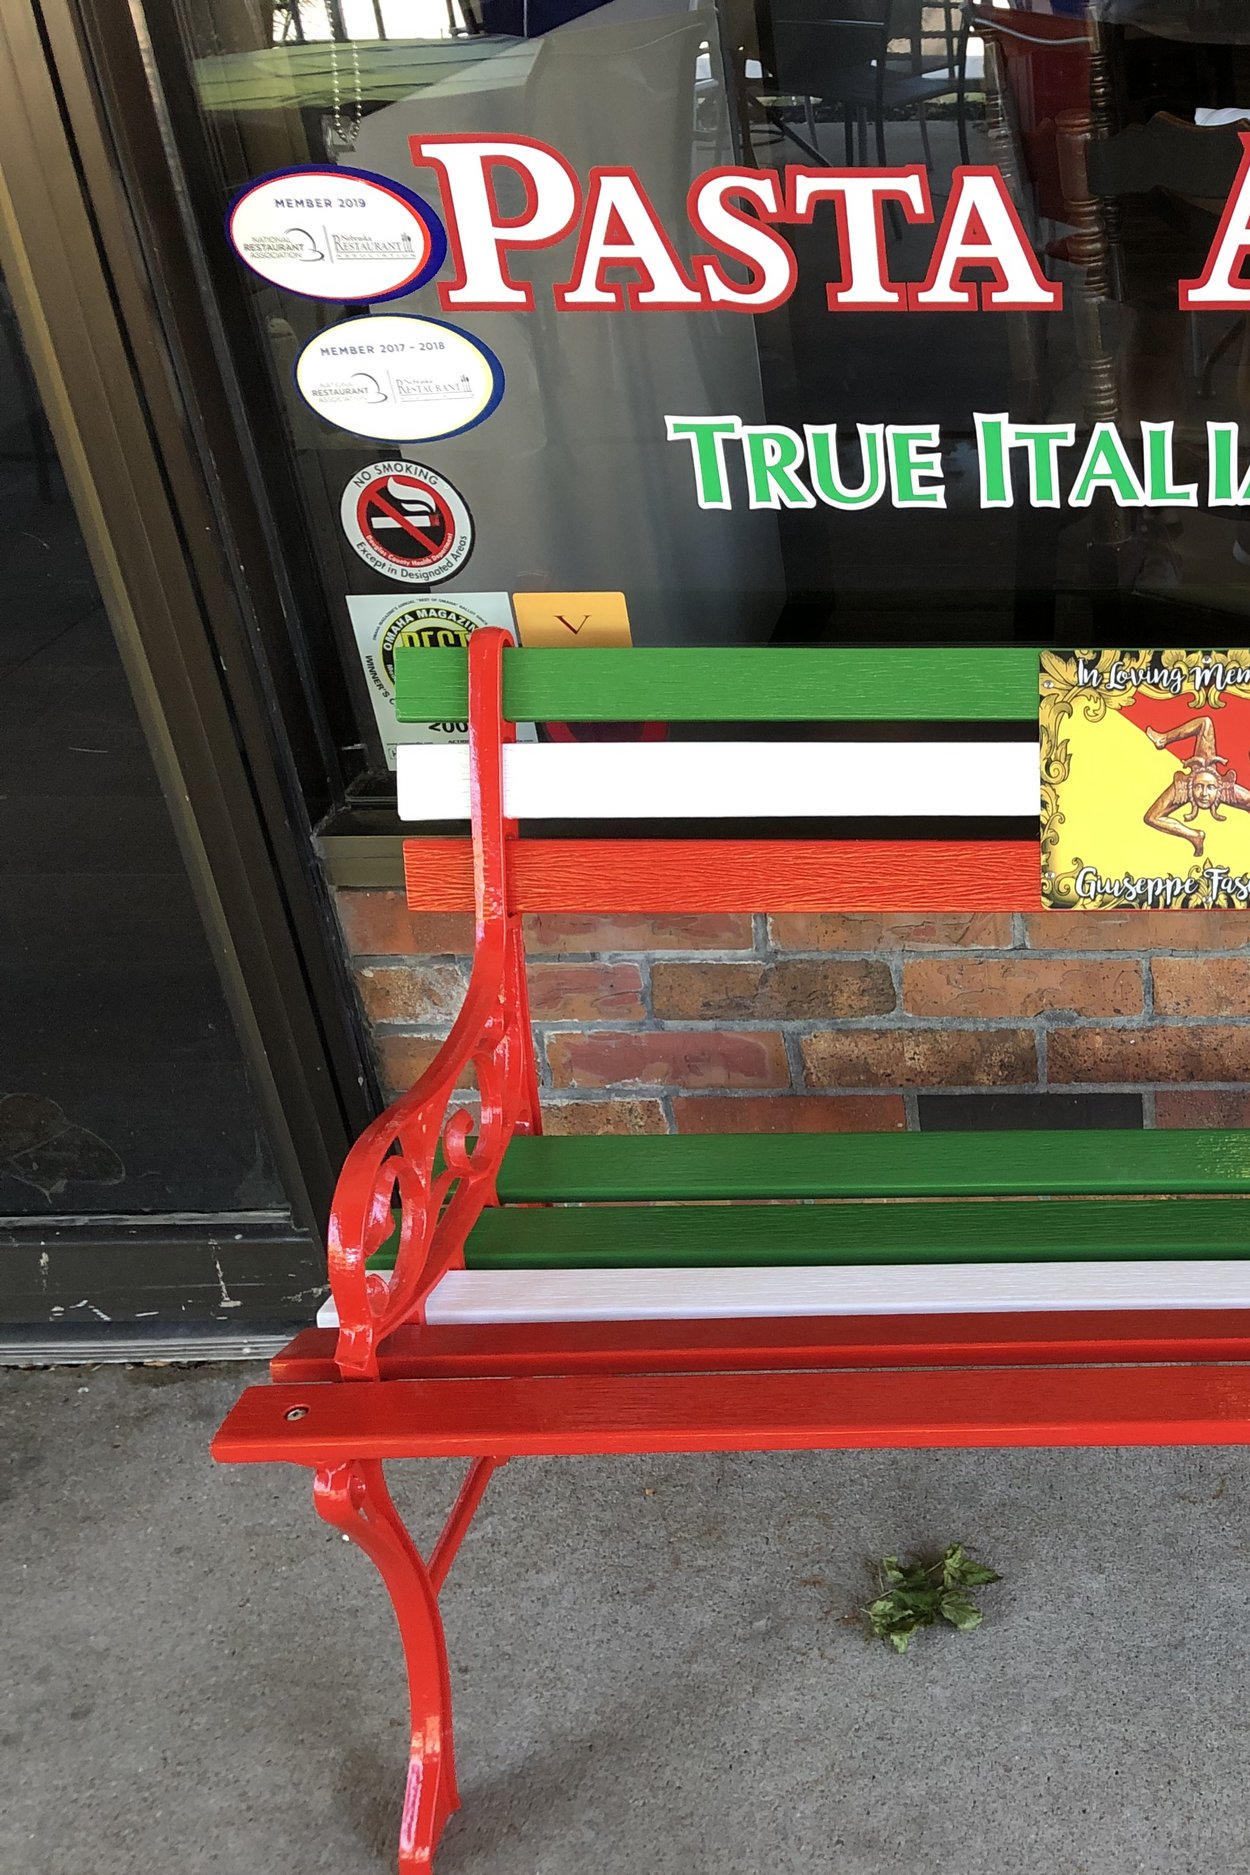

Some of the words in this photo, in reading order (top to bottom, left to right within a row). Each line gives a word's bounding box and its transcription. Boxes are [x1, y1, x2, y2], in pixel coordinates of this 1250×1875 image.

[274, 198, 332, 208] MEMBER
[337, 198, 366, 208] 2019
[408, 133, 1063, 313] PASTA
[332, 234, 402, 251] RESTAURANT
[320, 345, 374, 356] MEMBER
[380, 343, 405, 353] 2017
[418, 341, 445, 351] 2018
[312, 387, 368, 396] RESTAURANT
[353, 471, 371, 488] NO
[374, 463, 438, 485] SMOKING
[664, 414, 947, 510] TRUE
[356, 541, 386, 569] Except
[388, 564, 397, 575] in
[400, 558, 454, 581] Designated
[451, 535, 467, 562] Areas
[383, 613, 415, 651] OMAHA
[416, 608, 477, 633] MAGAZIN
[365, 655, 391, 698] WINNER'S
[1077, 658, 1102, 687] In
[1105, 661, 1186, 694] Loving
[1074, 866, 1199, 905] Giuseppe
